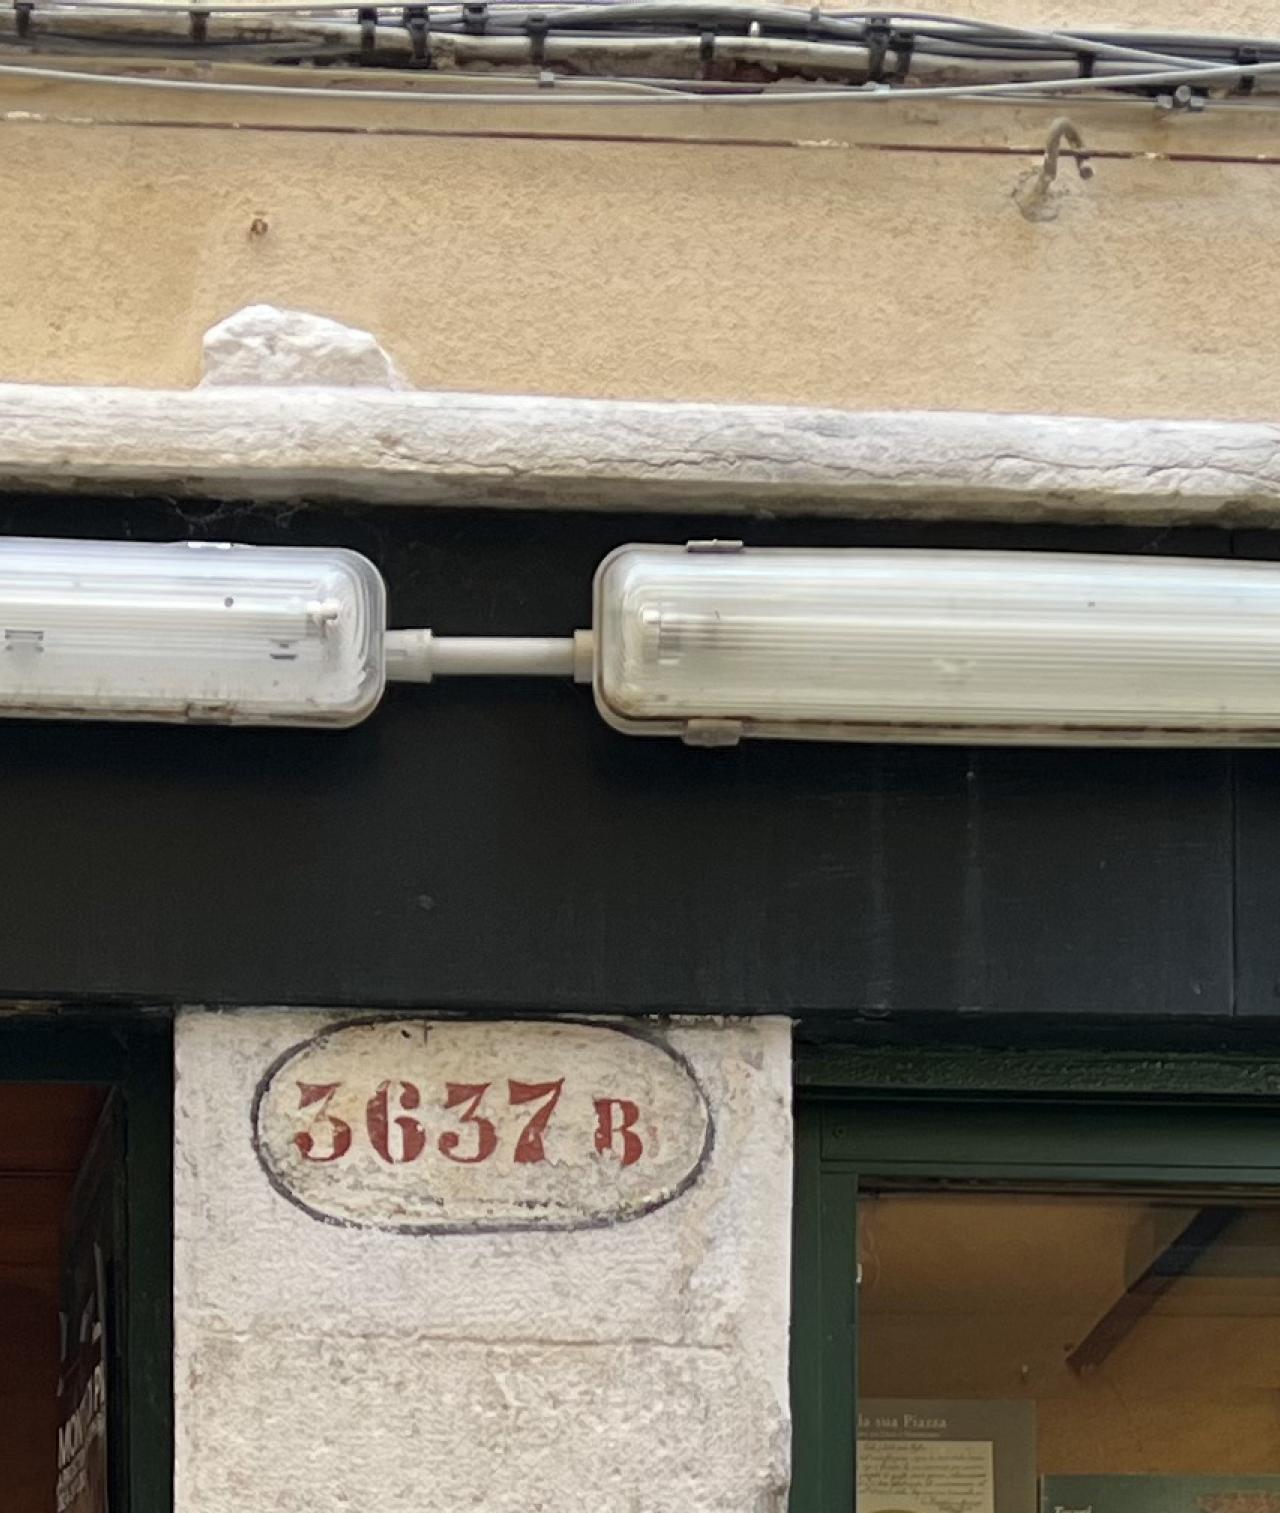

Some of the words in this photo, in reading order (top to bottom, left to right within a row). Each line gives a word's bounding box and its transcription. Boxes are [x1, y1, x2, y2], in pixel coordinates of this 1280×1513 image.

[294, 1077, 565, 1164] 3637
[592, 1098, 644, 1166] B
[875, 1416, 900, 1429] sua
[903, 1414, 947, 1429] Piazza
